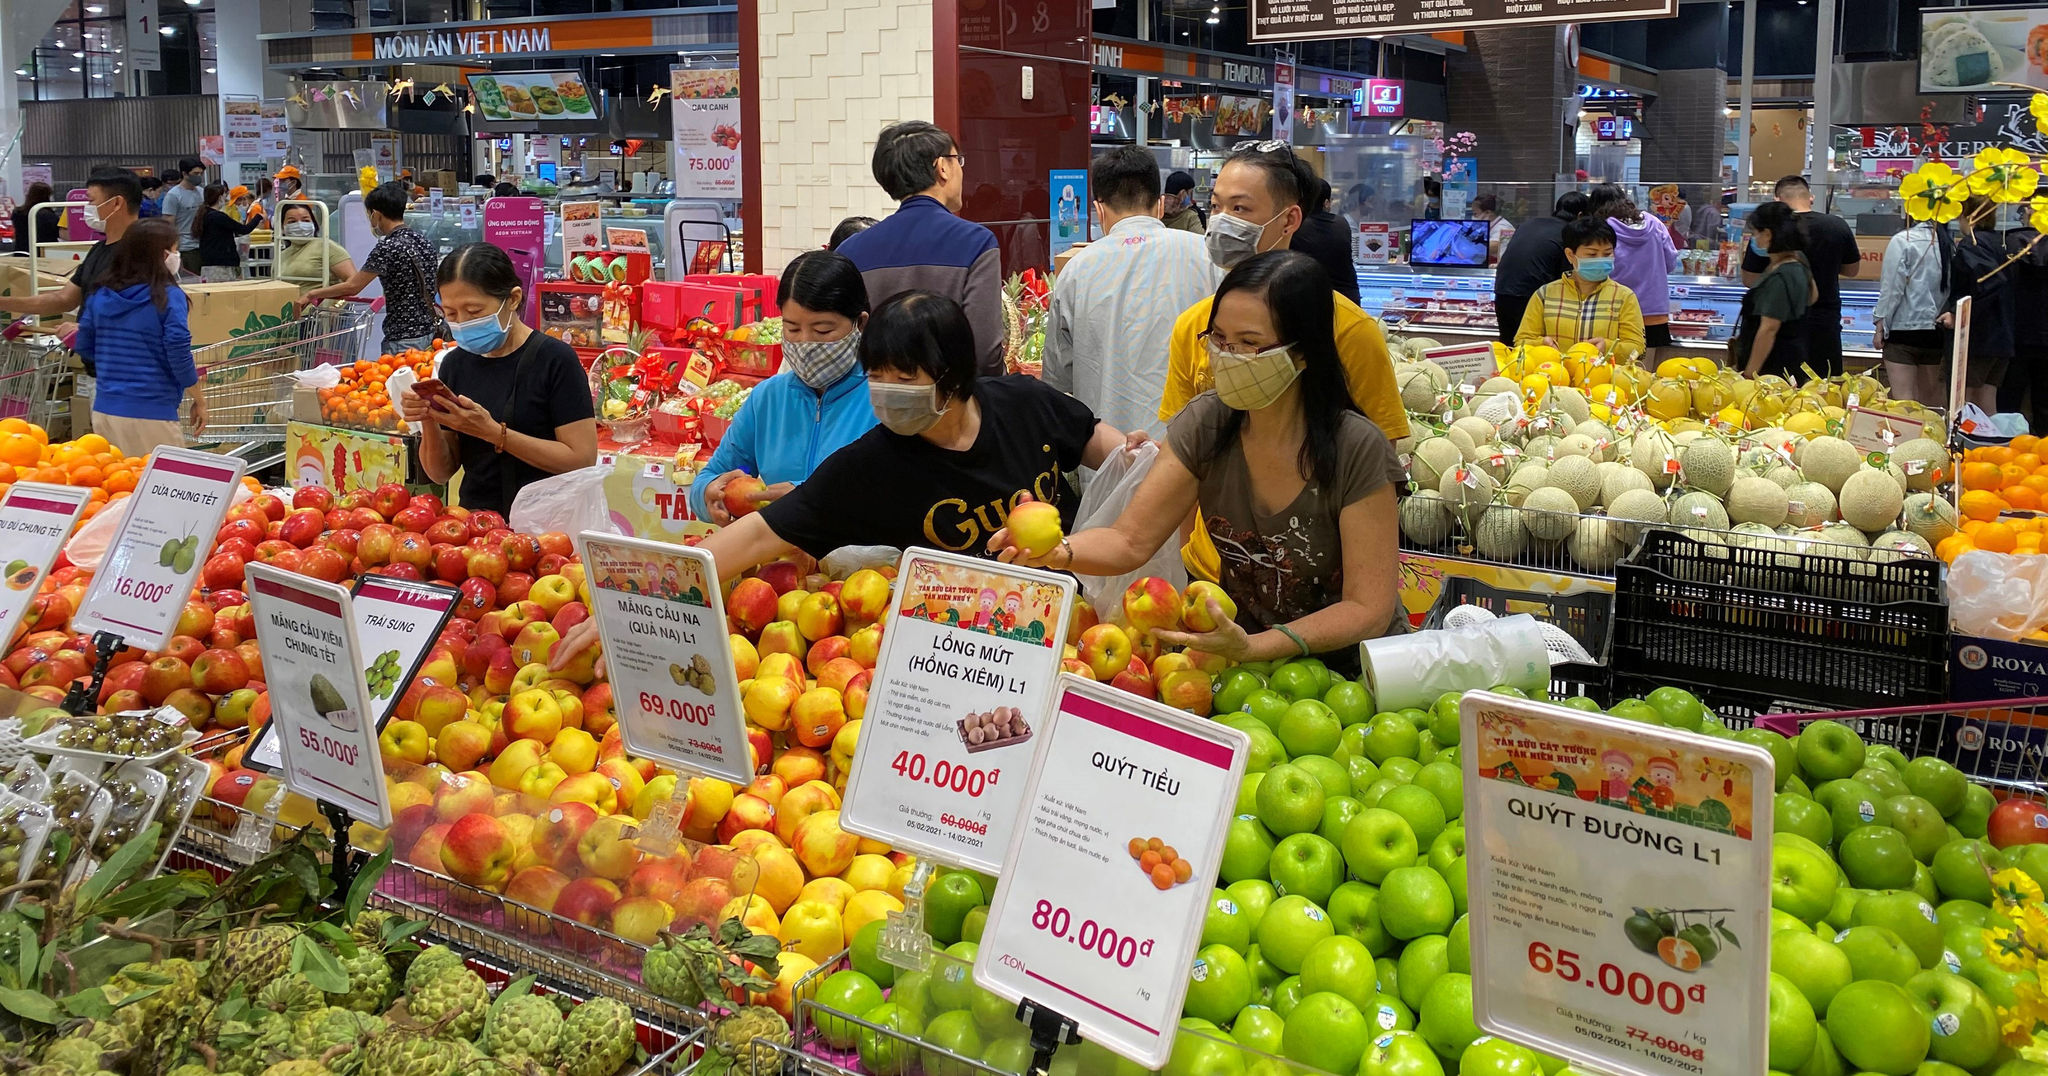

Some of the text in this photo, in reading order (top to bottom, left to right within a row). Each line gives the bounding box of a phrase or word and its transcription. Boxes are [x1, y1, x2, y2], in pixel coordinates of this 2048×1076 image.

[1310, 13, 1324, 22] CAM
[1524, 4, 1542, 12] XANH
[139, 16, 148, 34] 1
[423, 29, 451, 57] ĂN
[502, 28, 550, 53] NAM
[1224, 62, 1266, 85] TEMPURA
[1377, 106, 1396, 114] VND
[655, 488, 697, 520] TÂ
[114, 576, 174, 603] 16.000đ
[365, 614, 415, 632] TRÁI SUNG
[682, 612, 701, 626] NA
[320, 630, 344, 648] XIÊM
[660, 626, 680, 644] NA)
[683, 631, 696, 644] L1
[980, 645, 1014, 666] MỨT
[1992, 656, 2048, 676] ROYA
[961, 667, 1004, 693] XIÊM)
[1008, 678, 1026, 694] L1
[640, 692, 715, 726] 69.000đ
[300, 726, 358, 766] 55.000đ
[1494, 738, 1514, 747] TÂN
[1540, 740, 1560, 752] CÁT
[1989, 736, 2048, 758] ROYA
[1506, 749, 1528, 758] TÂN
[1530, 751, 1554, 762] NIÊN
[1557, 754, 1578, 765] NHƯ
[891, 750, 1000, 797] 40.000đ
[1092, 752, 1180, 796] QUÝT TIỀU
[898, 804, 910, 814] Giá
[982, 810, 992, 820] kg
[1074, 806, 1087, 816] Nam
[906, 820, 984, 848] 05/02/2021 14/02/2021
[1508, 798, 1720, 866] QUÝT ĐƯỜNG L1
[1538, 867, 1556, 878] Nam
[1032, 898, 1156, 968] 80.000đ
[1528, 942, 1707, 1015] 65.000đ
[1556, 1007, 1574, 1020] Giá
[1692, 1032, 1707, 1045] kg
[1574, 1026, 1704, 1075] 05/02/2021 14/02/2021
